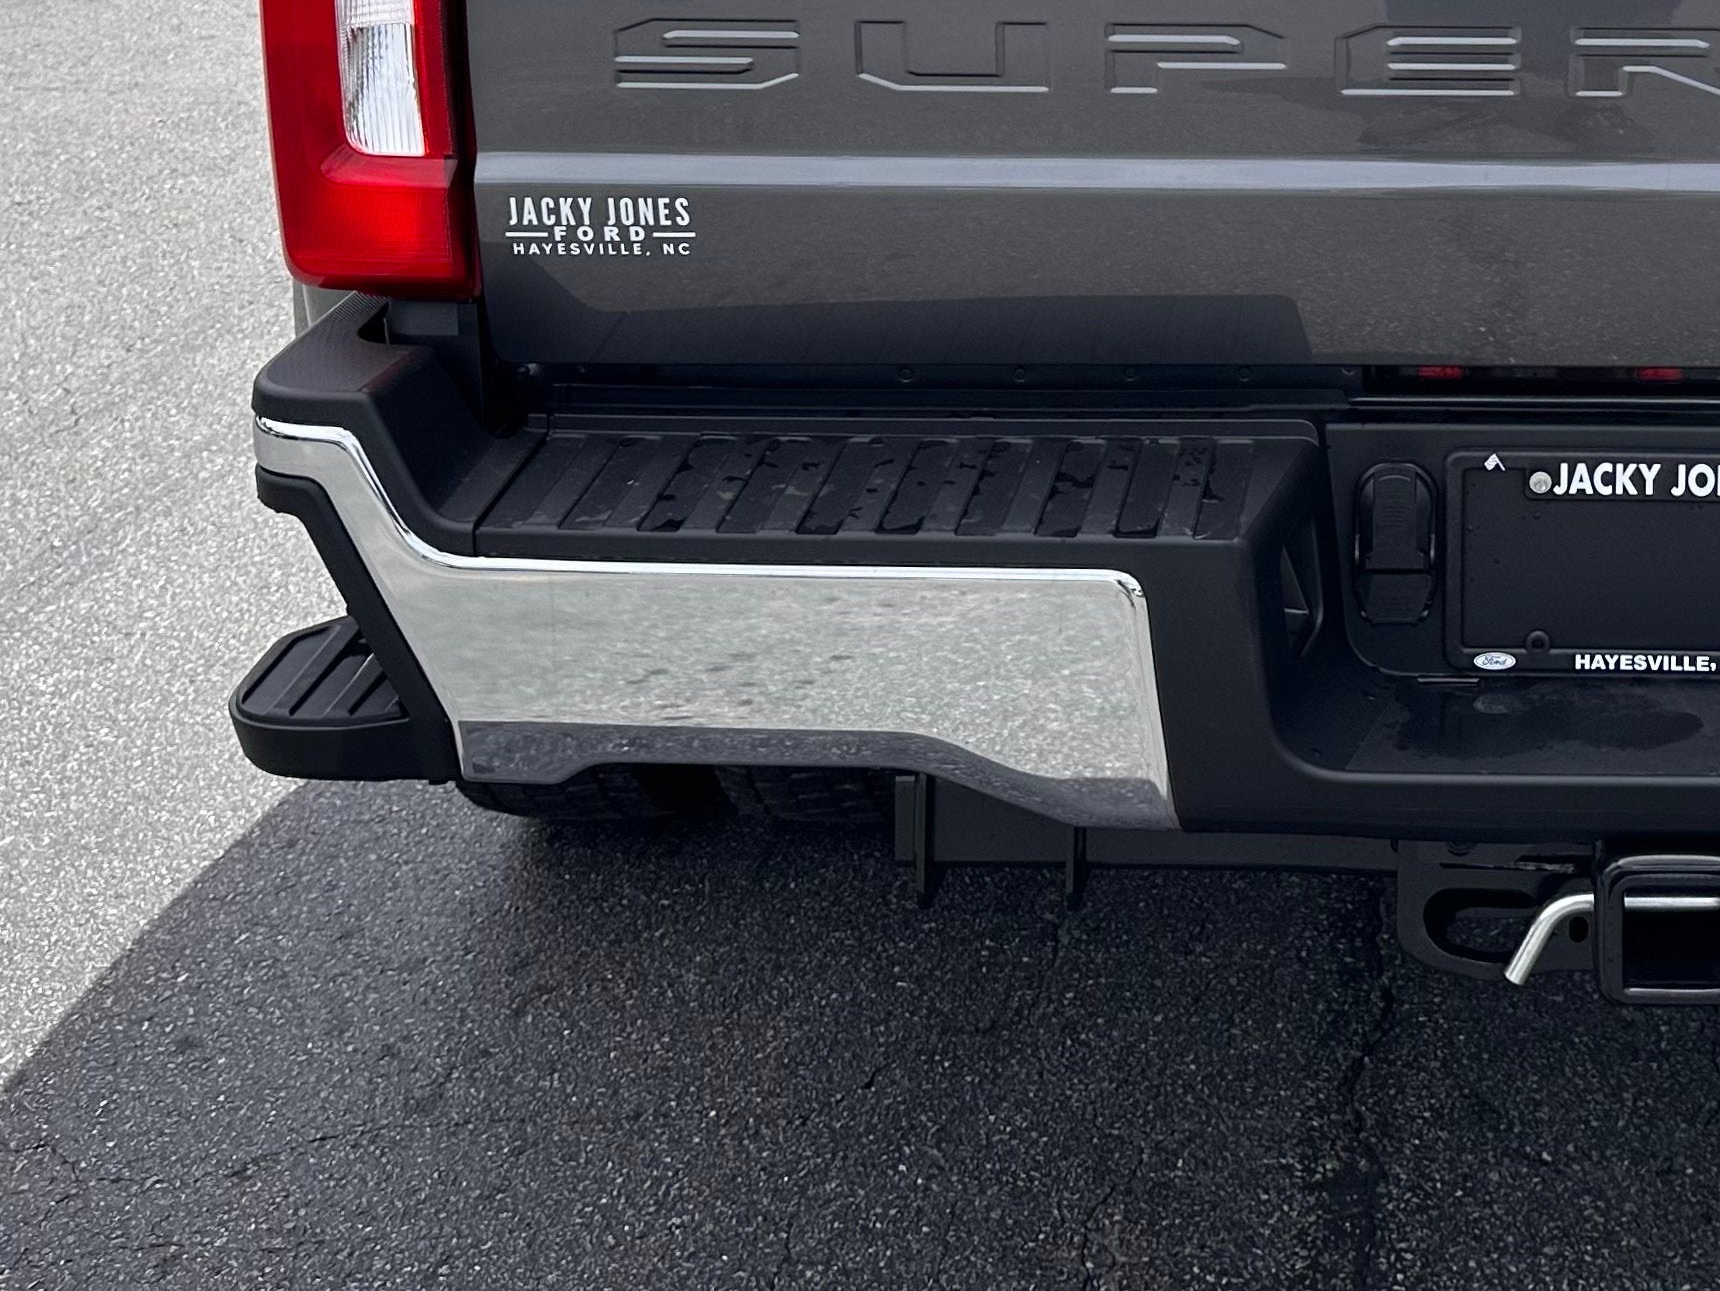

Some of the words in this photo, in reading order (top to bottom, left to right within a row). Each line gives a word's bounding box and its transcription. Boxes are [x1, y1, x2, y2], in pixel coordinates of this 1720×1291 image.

[508, 197, 592, 226] JACKY
[607, 197, 691, 226] JONES
[553, 226, 646, 242] FORD
[513, 243, 651, 257] HAYESVILLE,
[662, 243, 691, 255] NC
[1552, 462, 1662, 496] JACKY
[1479, 654, 1510, 667] Ford
[1574, 653, 1718, 672] HAYESVILLE,
